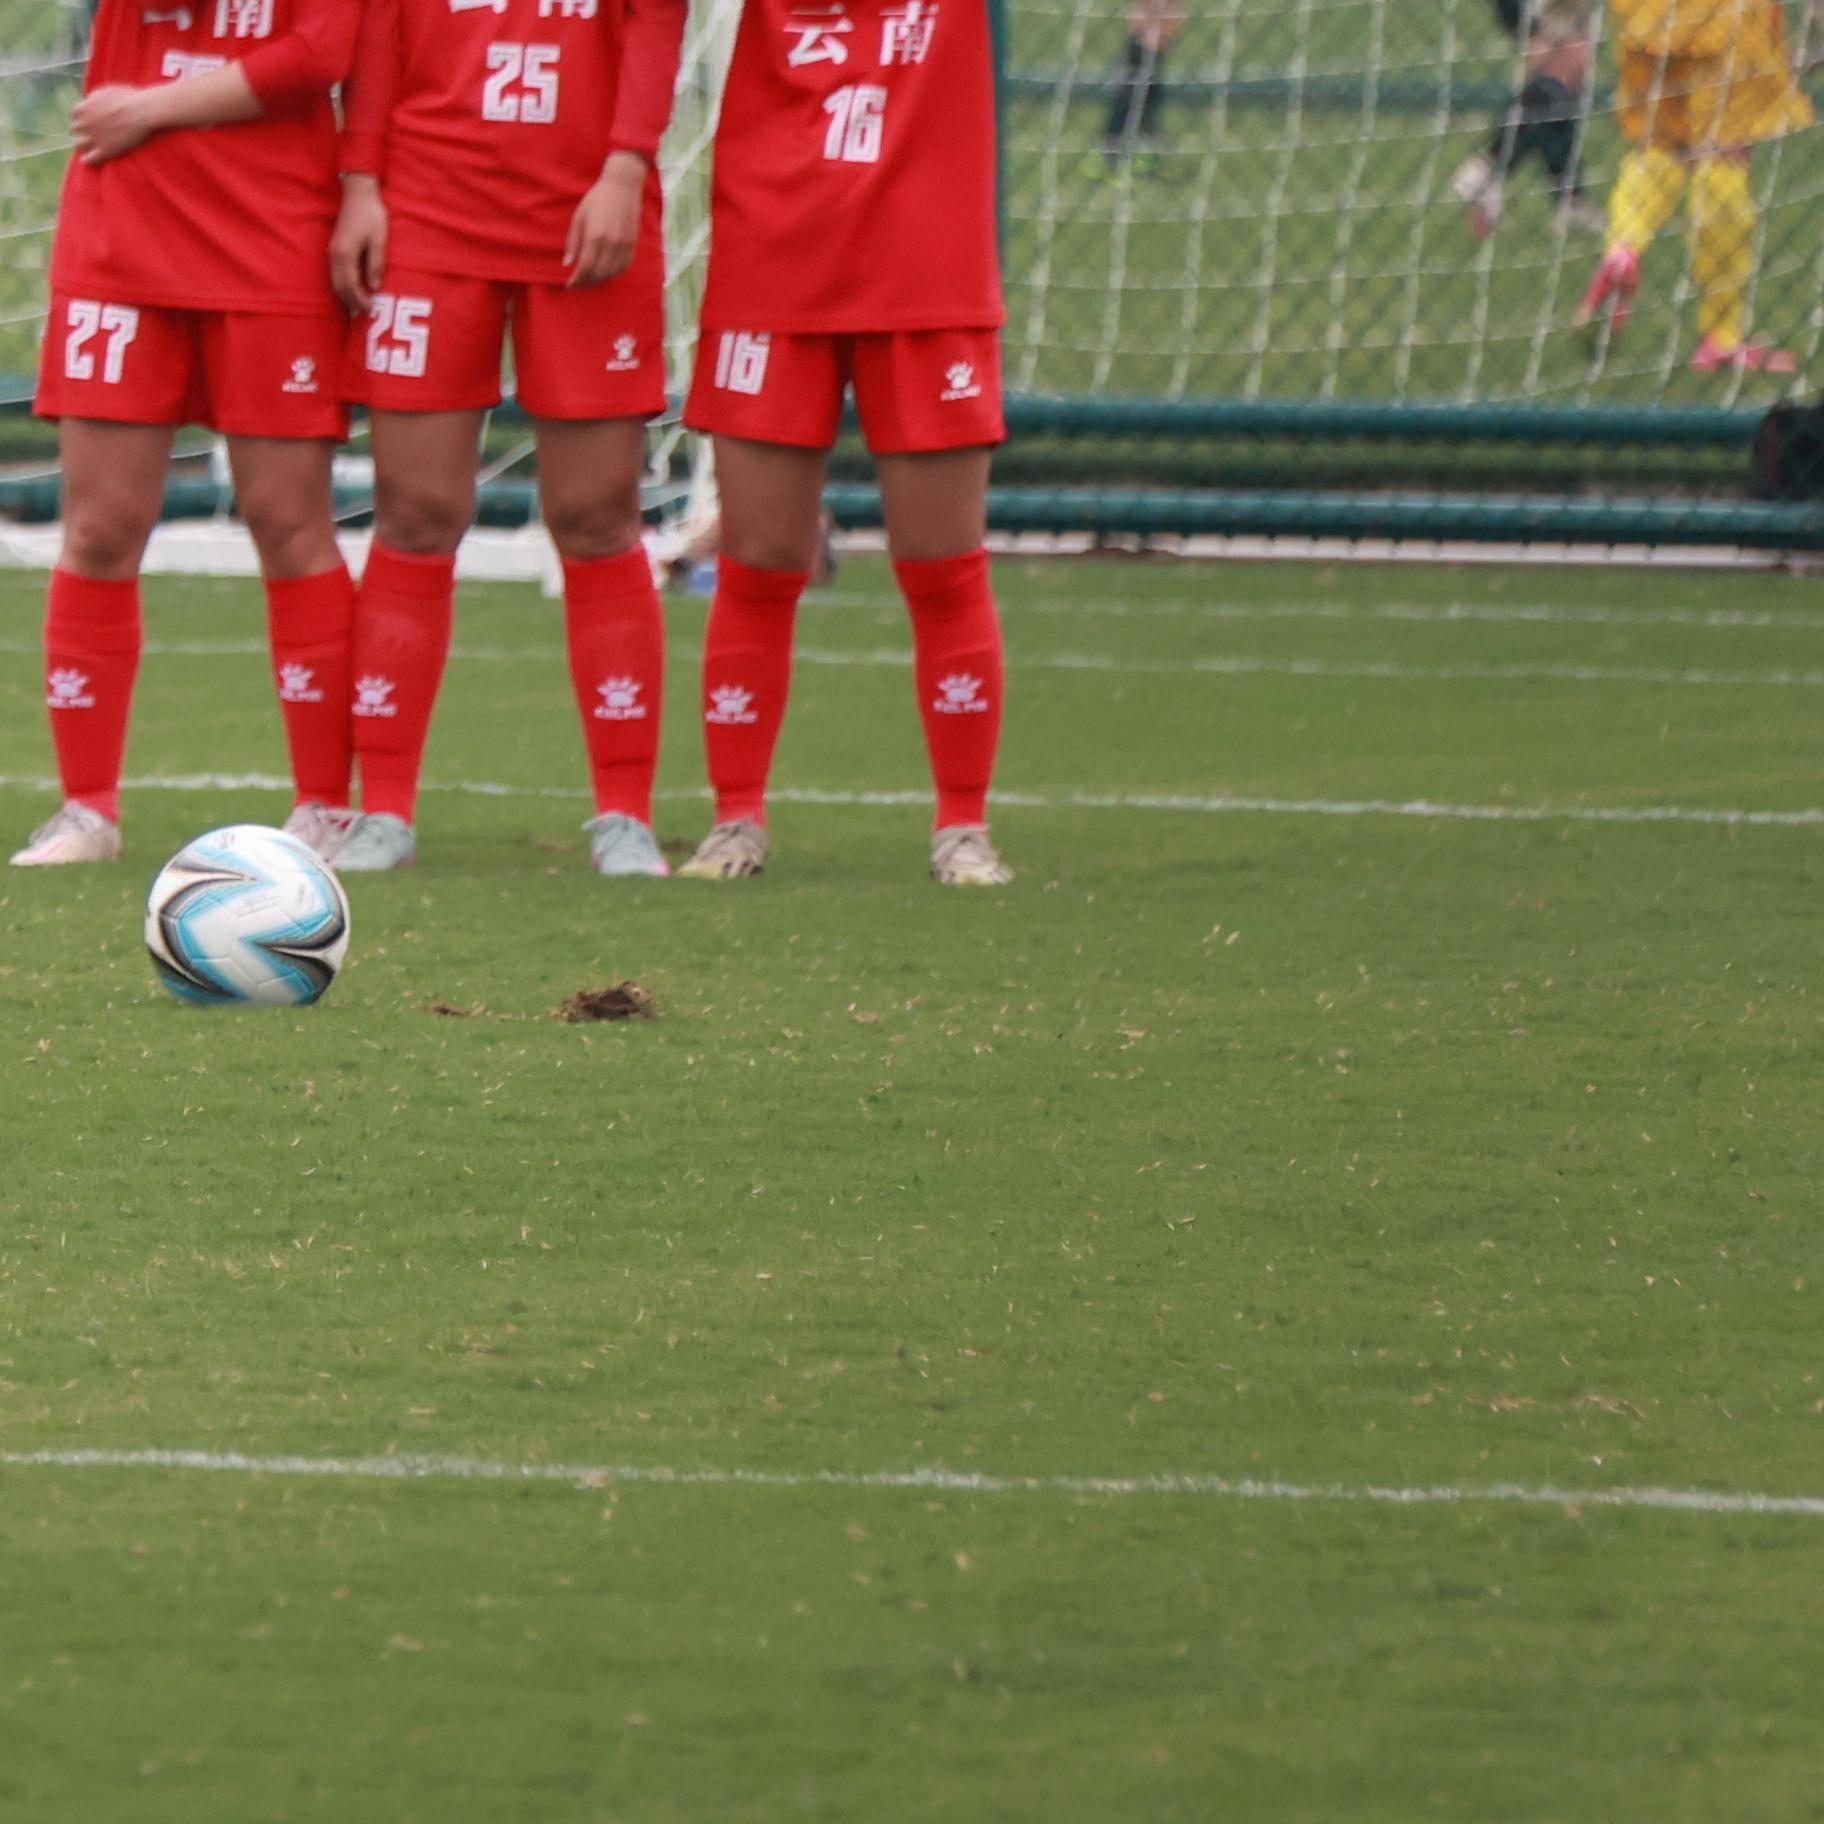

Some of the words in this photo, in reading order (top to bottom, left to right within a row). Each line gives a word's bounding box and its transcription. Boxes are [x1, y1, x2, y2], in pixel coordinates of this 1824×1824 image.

[482, 43, 561, 124] 25
[823, 85, 887, 163] 16
[64, 299, 139, 384] 27
[365, 294, 433, 377] 25
[714, 330, 771, 395] 16
